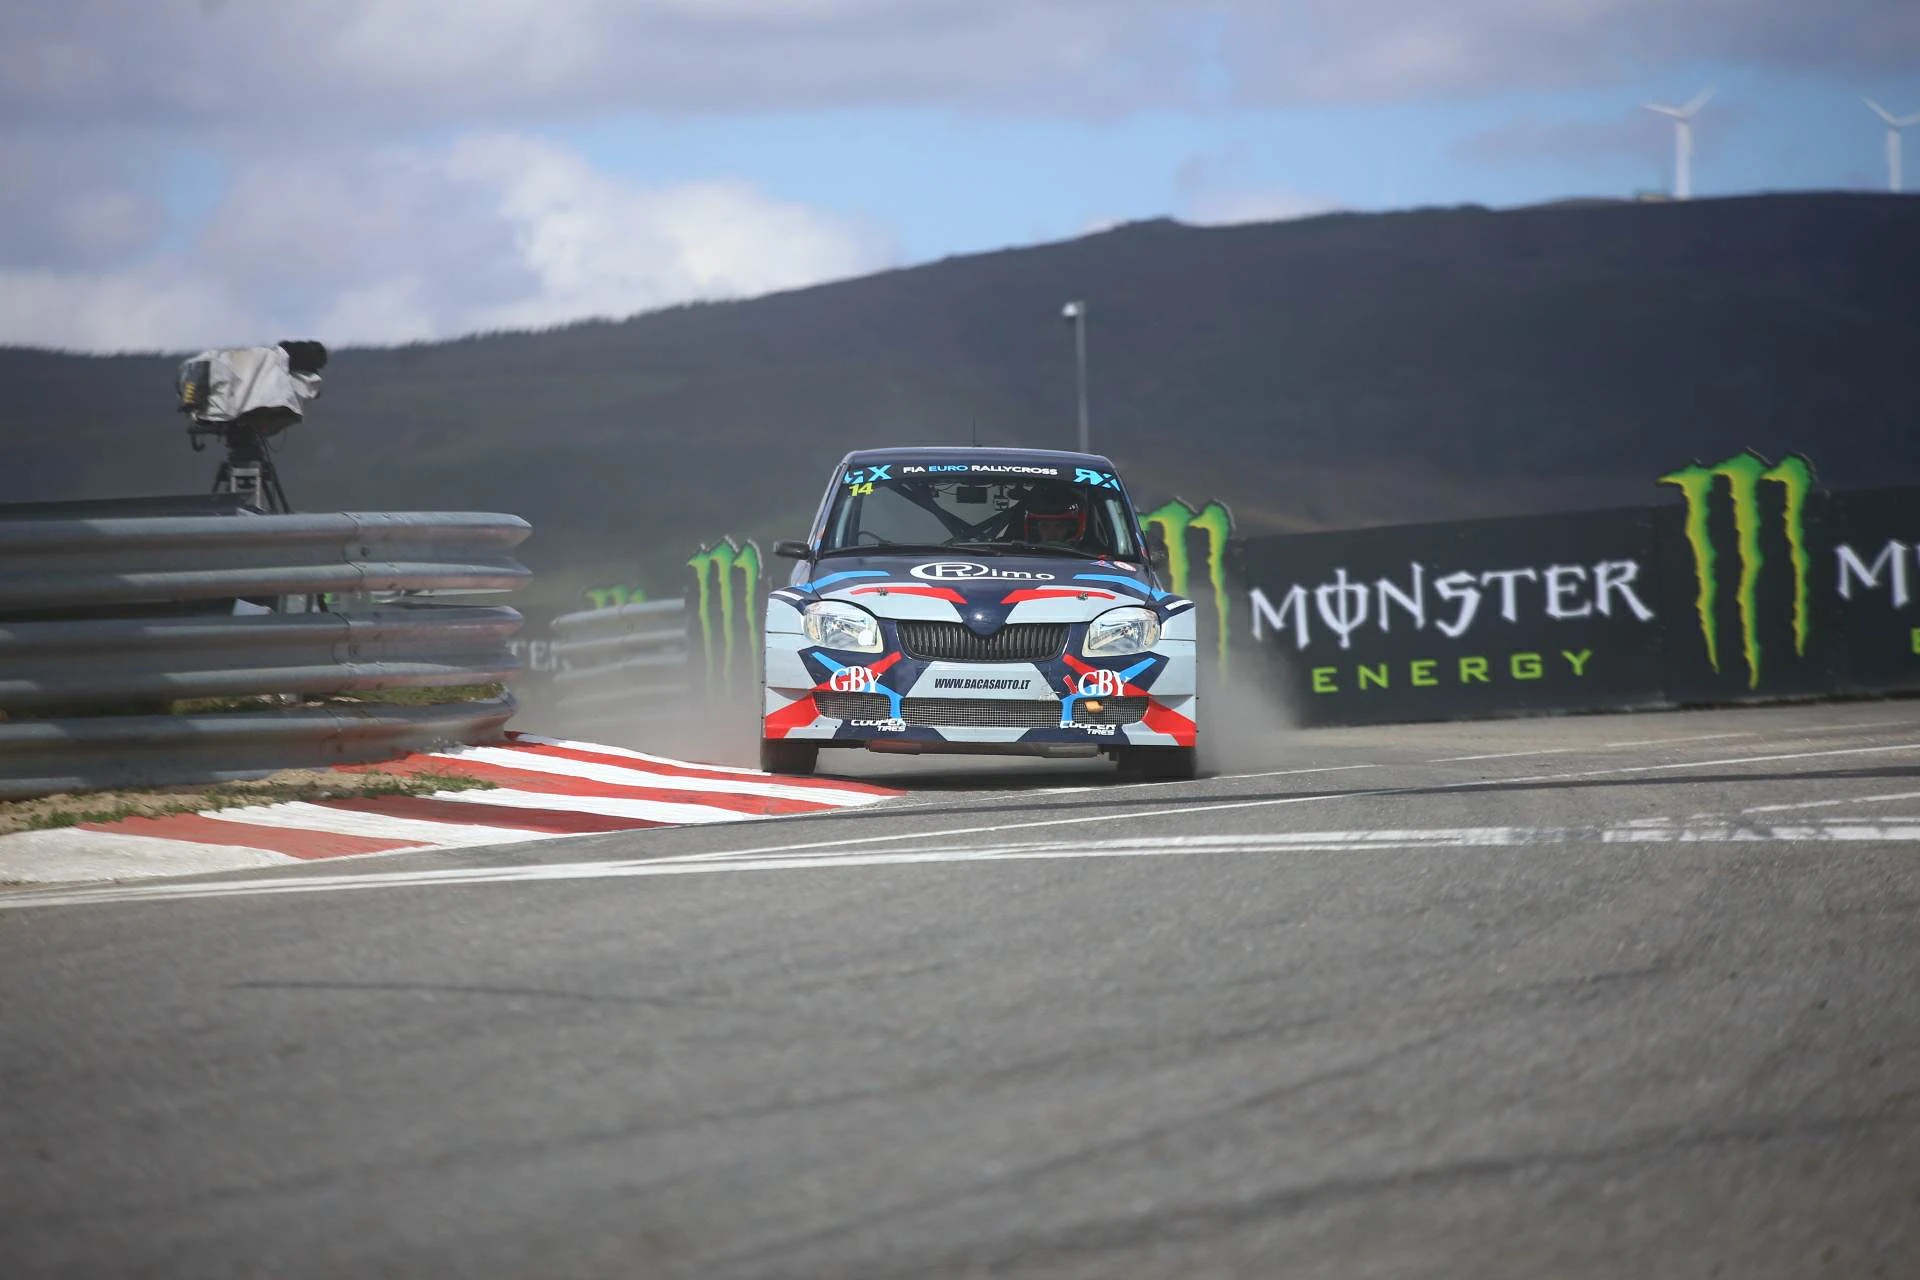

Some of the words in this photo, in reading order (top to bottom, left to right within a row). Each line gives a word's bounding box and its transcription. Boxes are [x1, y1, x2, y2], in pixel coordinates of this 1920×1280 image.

[903, 465, 926, 474] FIA
[928, 464, 969, 472] EURO
[971, 464, 1058, 476] RALLYCROSS
[848, 481, 875, 497] 14
[1248, 560, 1656, 650] MONSTER
[829, 665, 883, 694] GBY
[934, 678, 1032, 690] WWW.BACASAUTO.LT
[1077, 668, 1132, 697] GBY
[1311, 649, 1593, 694] ENERGY
